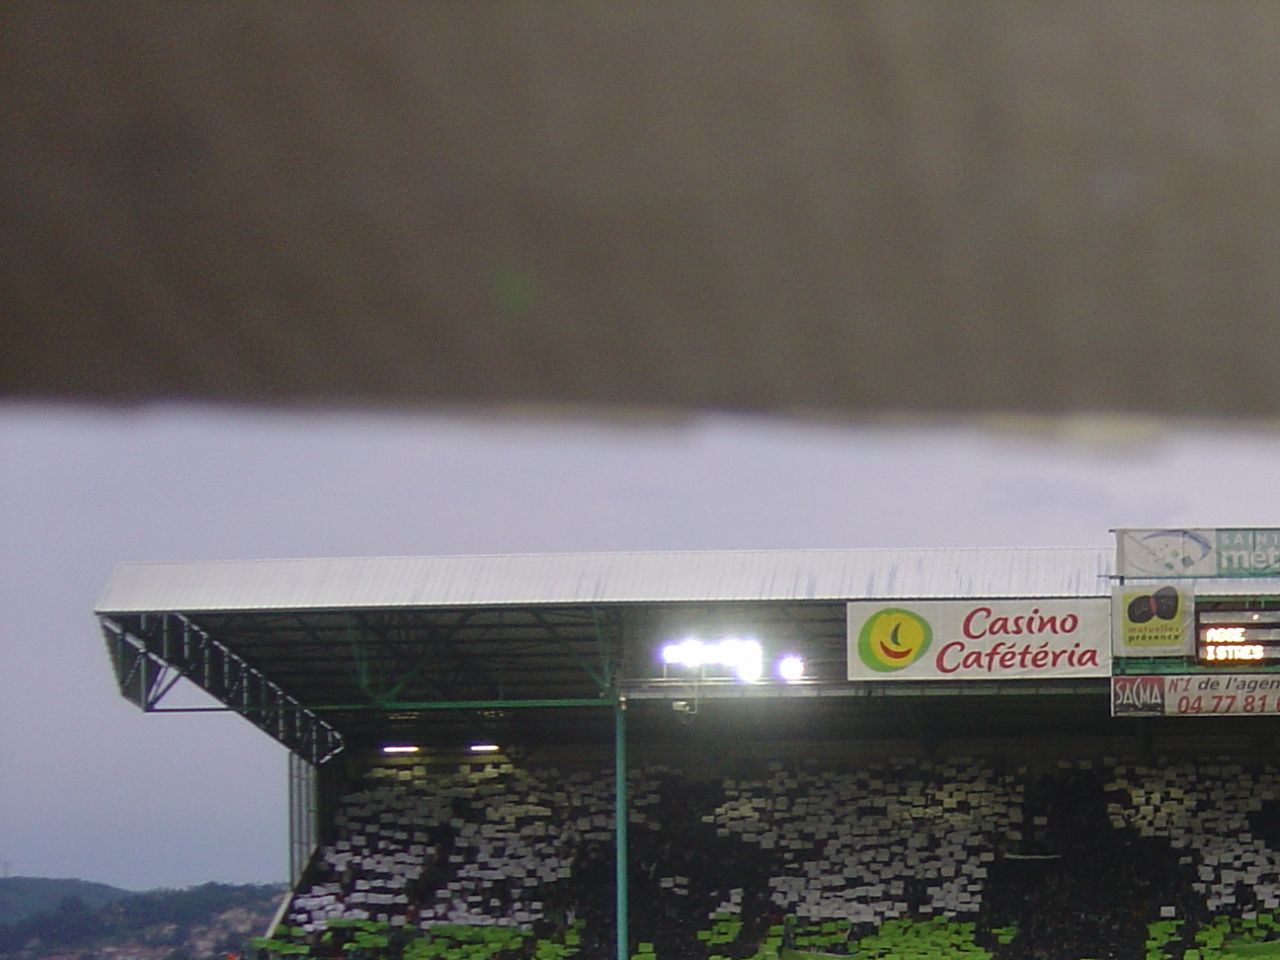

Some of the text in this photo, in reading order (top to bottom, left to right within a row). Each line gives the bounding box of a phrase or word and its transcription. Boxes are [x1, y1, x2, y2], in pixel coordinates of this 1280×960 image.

[962, 607, 1078, 640] Casino
[935, 641, 1098, 673] Cafétéria
[1115, 678, 1162, 708] SACMA
[1198, 678, 1220, 690] de
[1177, 695, 1202, 714] 04
[1211, 695, 1237, 713] 77
[1243, 694, 1268, 712] 81
